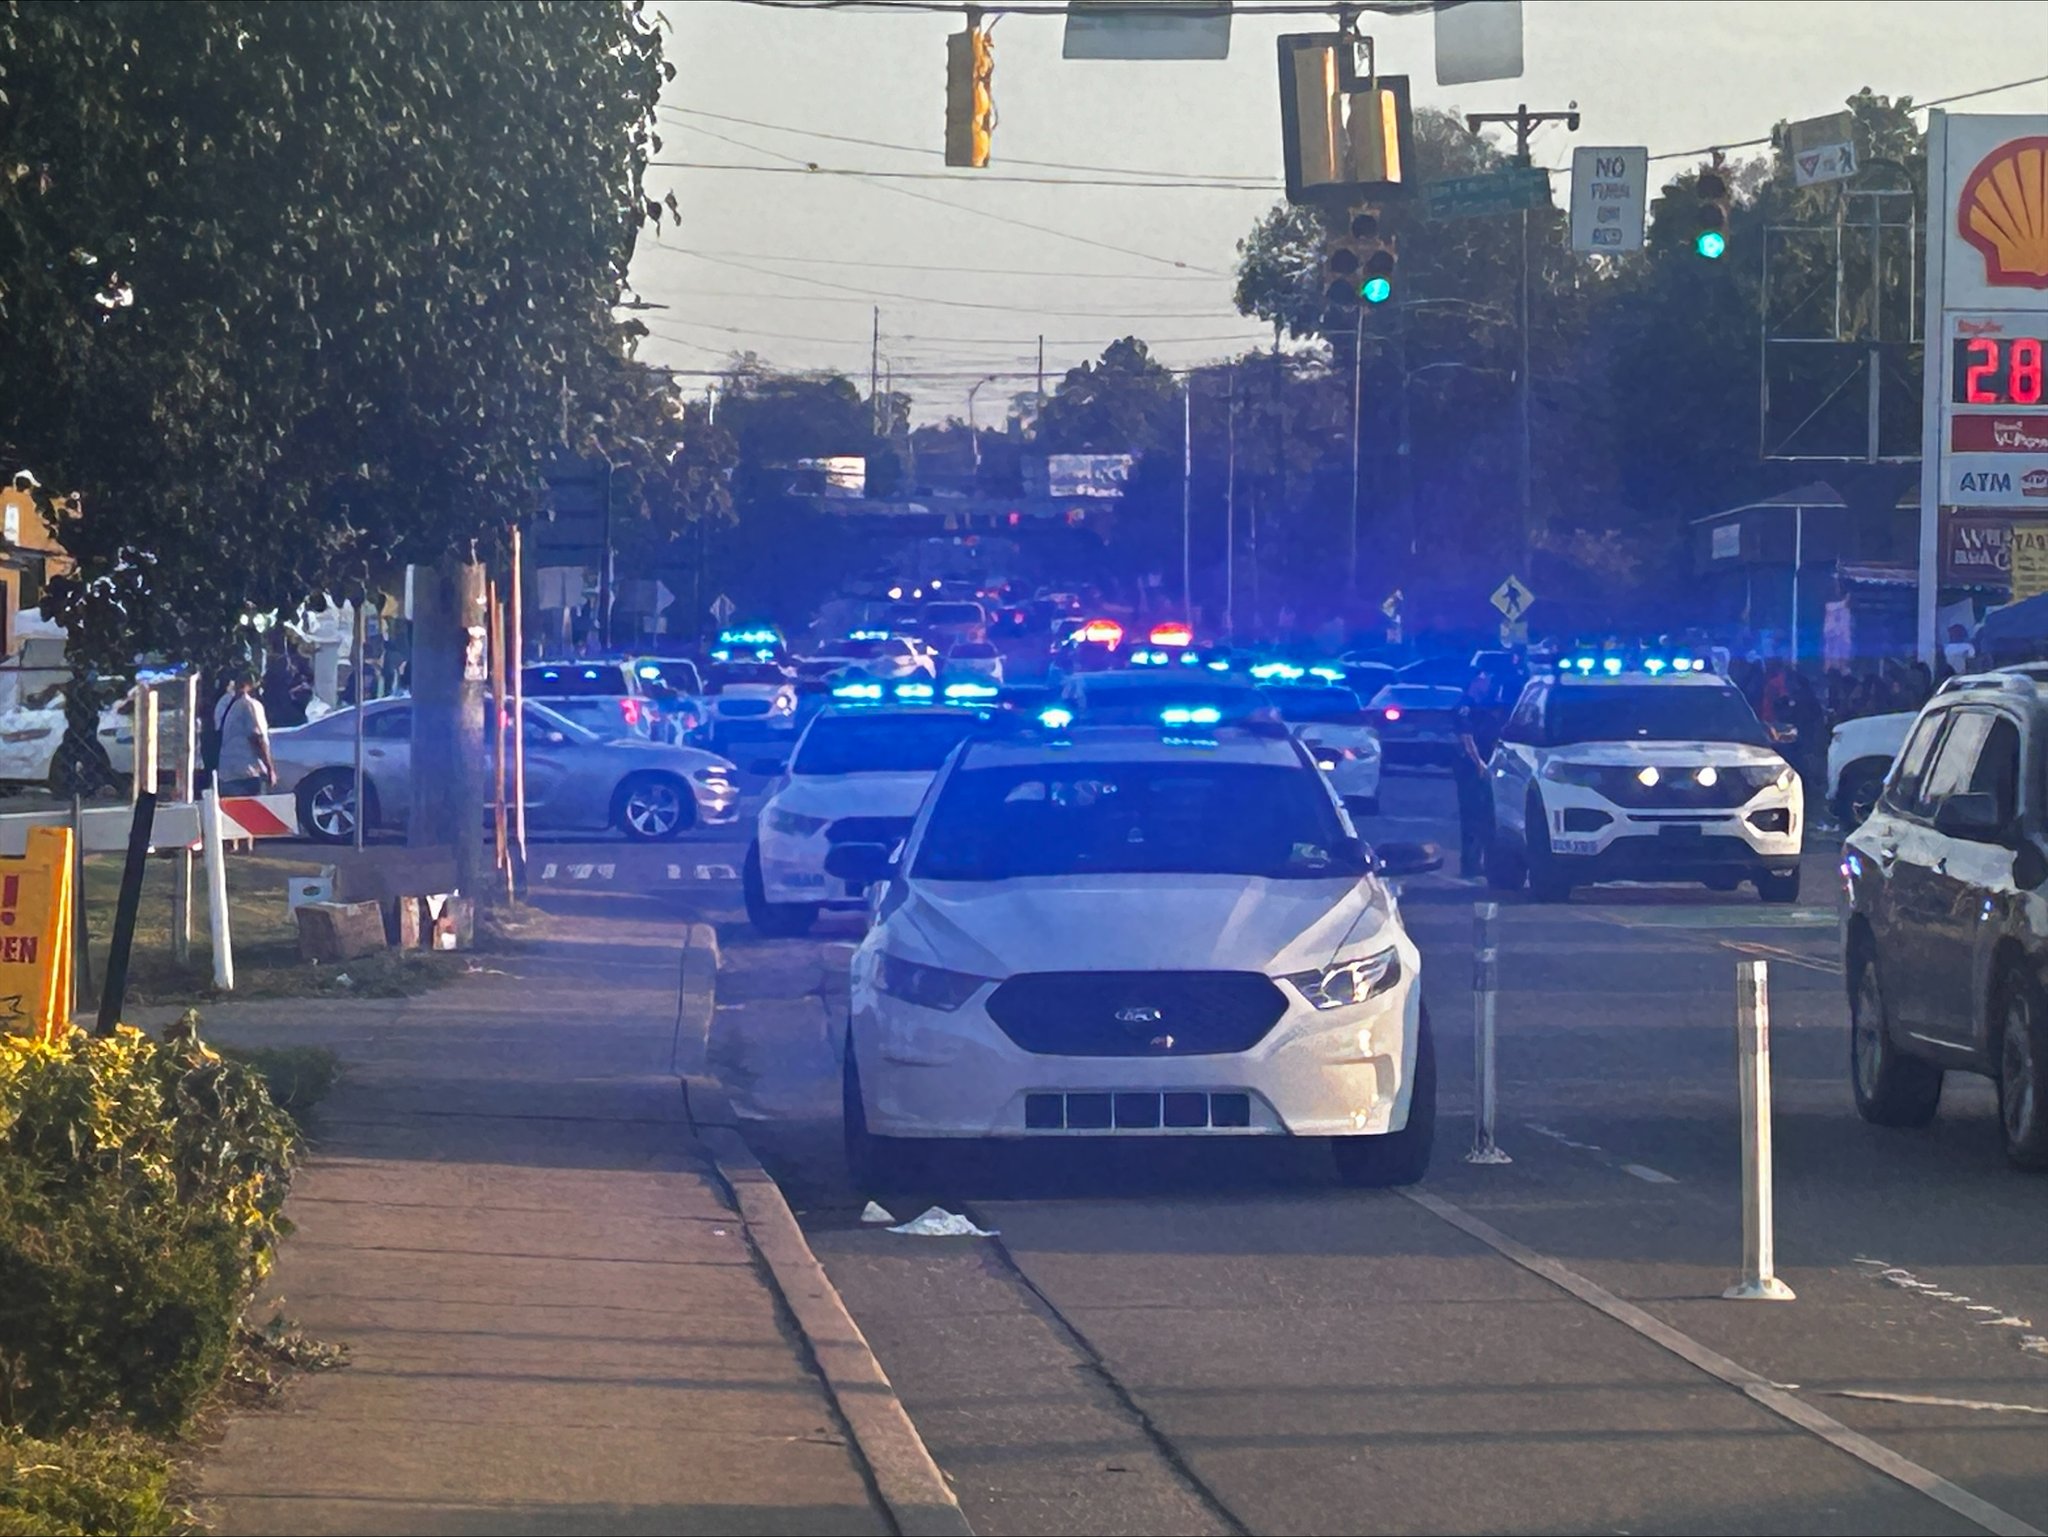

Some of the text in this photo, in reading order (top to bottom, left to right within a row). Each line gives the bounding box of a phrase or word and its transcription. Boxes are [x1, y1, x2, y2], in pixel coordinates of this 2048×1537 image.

[1596, 156, 1625, 178] NO
[1960, 471, 2012, 493] ATM
[0, 936, 38, 964] EN
